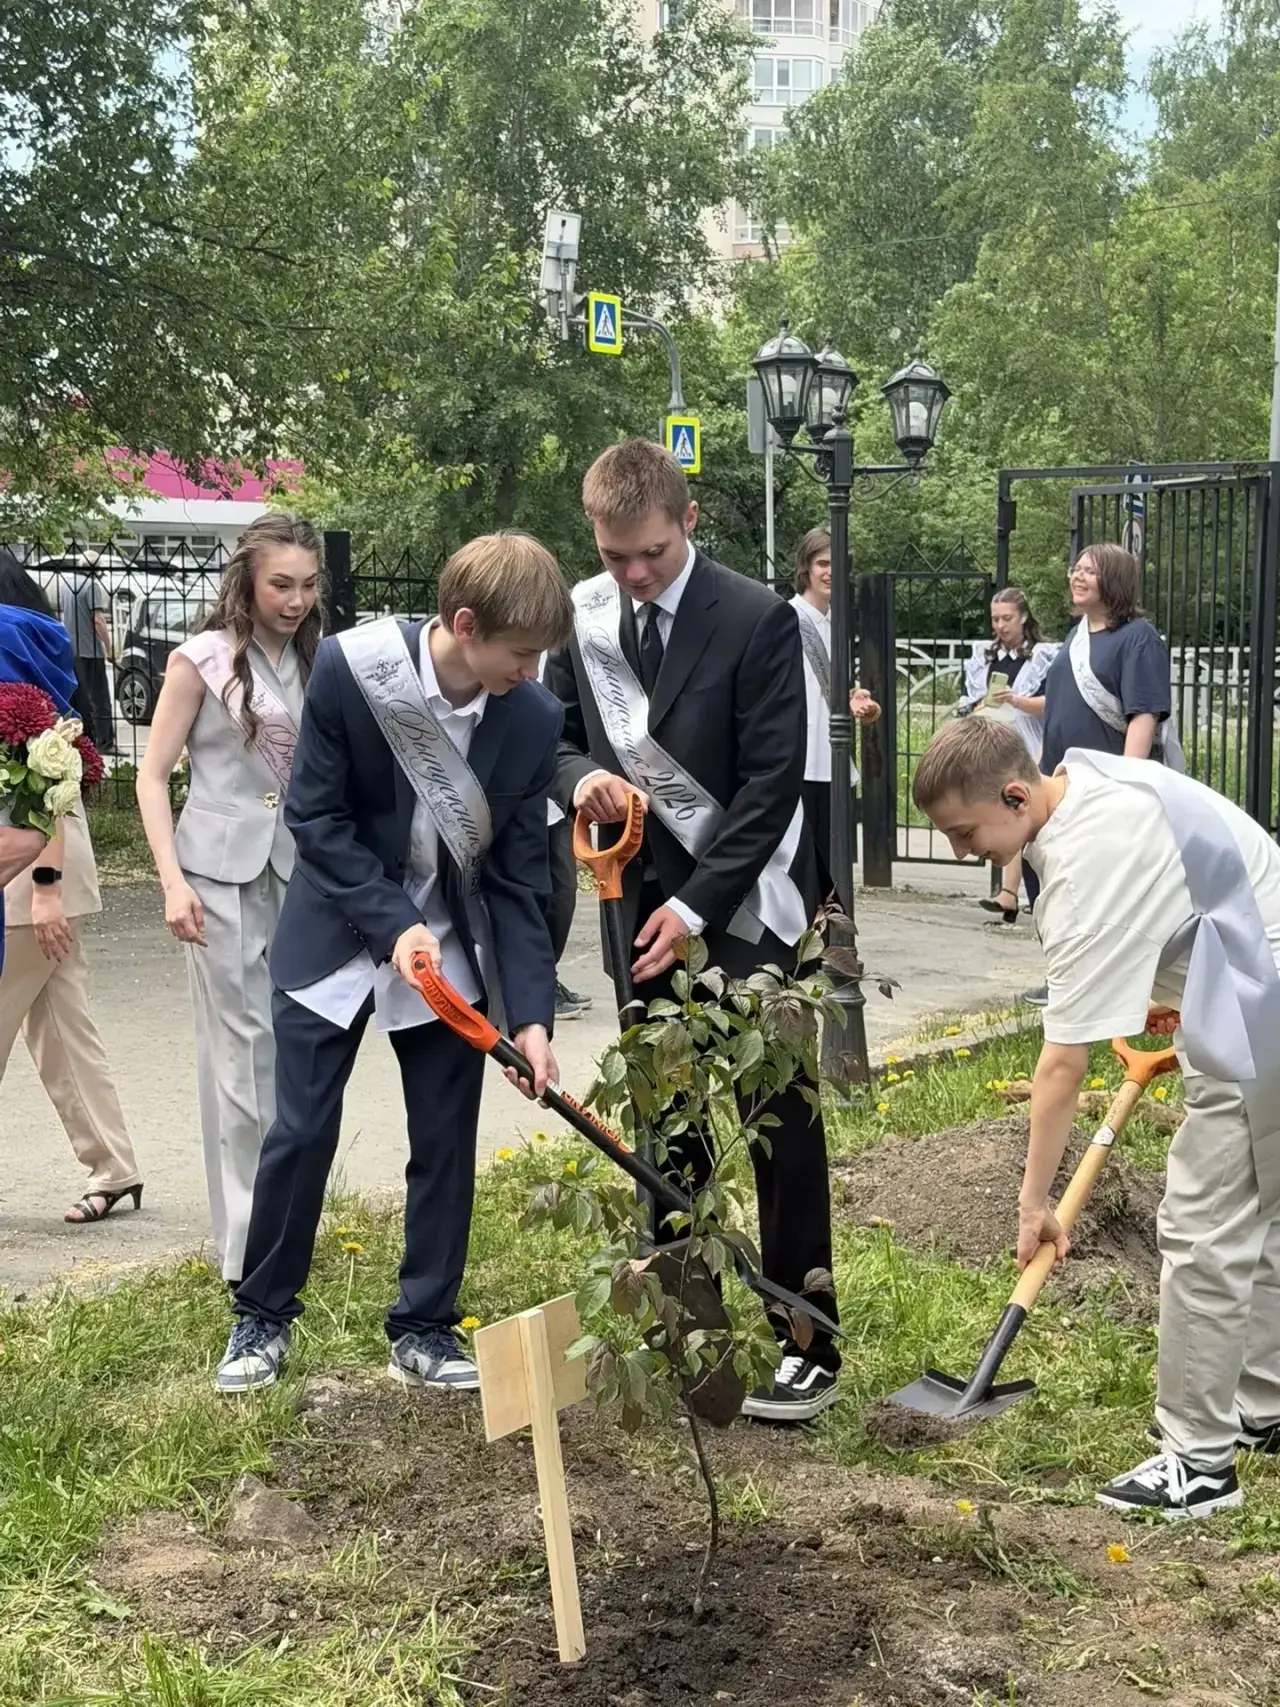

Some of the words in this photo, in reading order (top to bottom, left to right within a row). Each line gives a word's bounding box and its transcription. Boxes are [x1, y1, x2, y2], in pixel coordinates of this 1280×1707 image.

[386, 699, 482, 852] Выпускник
[585, 626, 650, 770] Выпускник
[639, 771, 710, 822] 2026
[423, 978, 461, 1021] FINLAND
